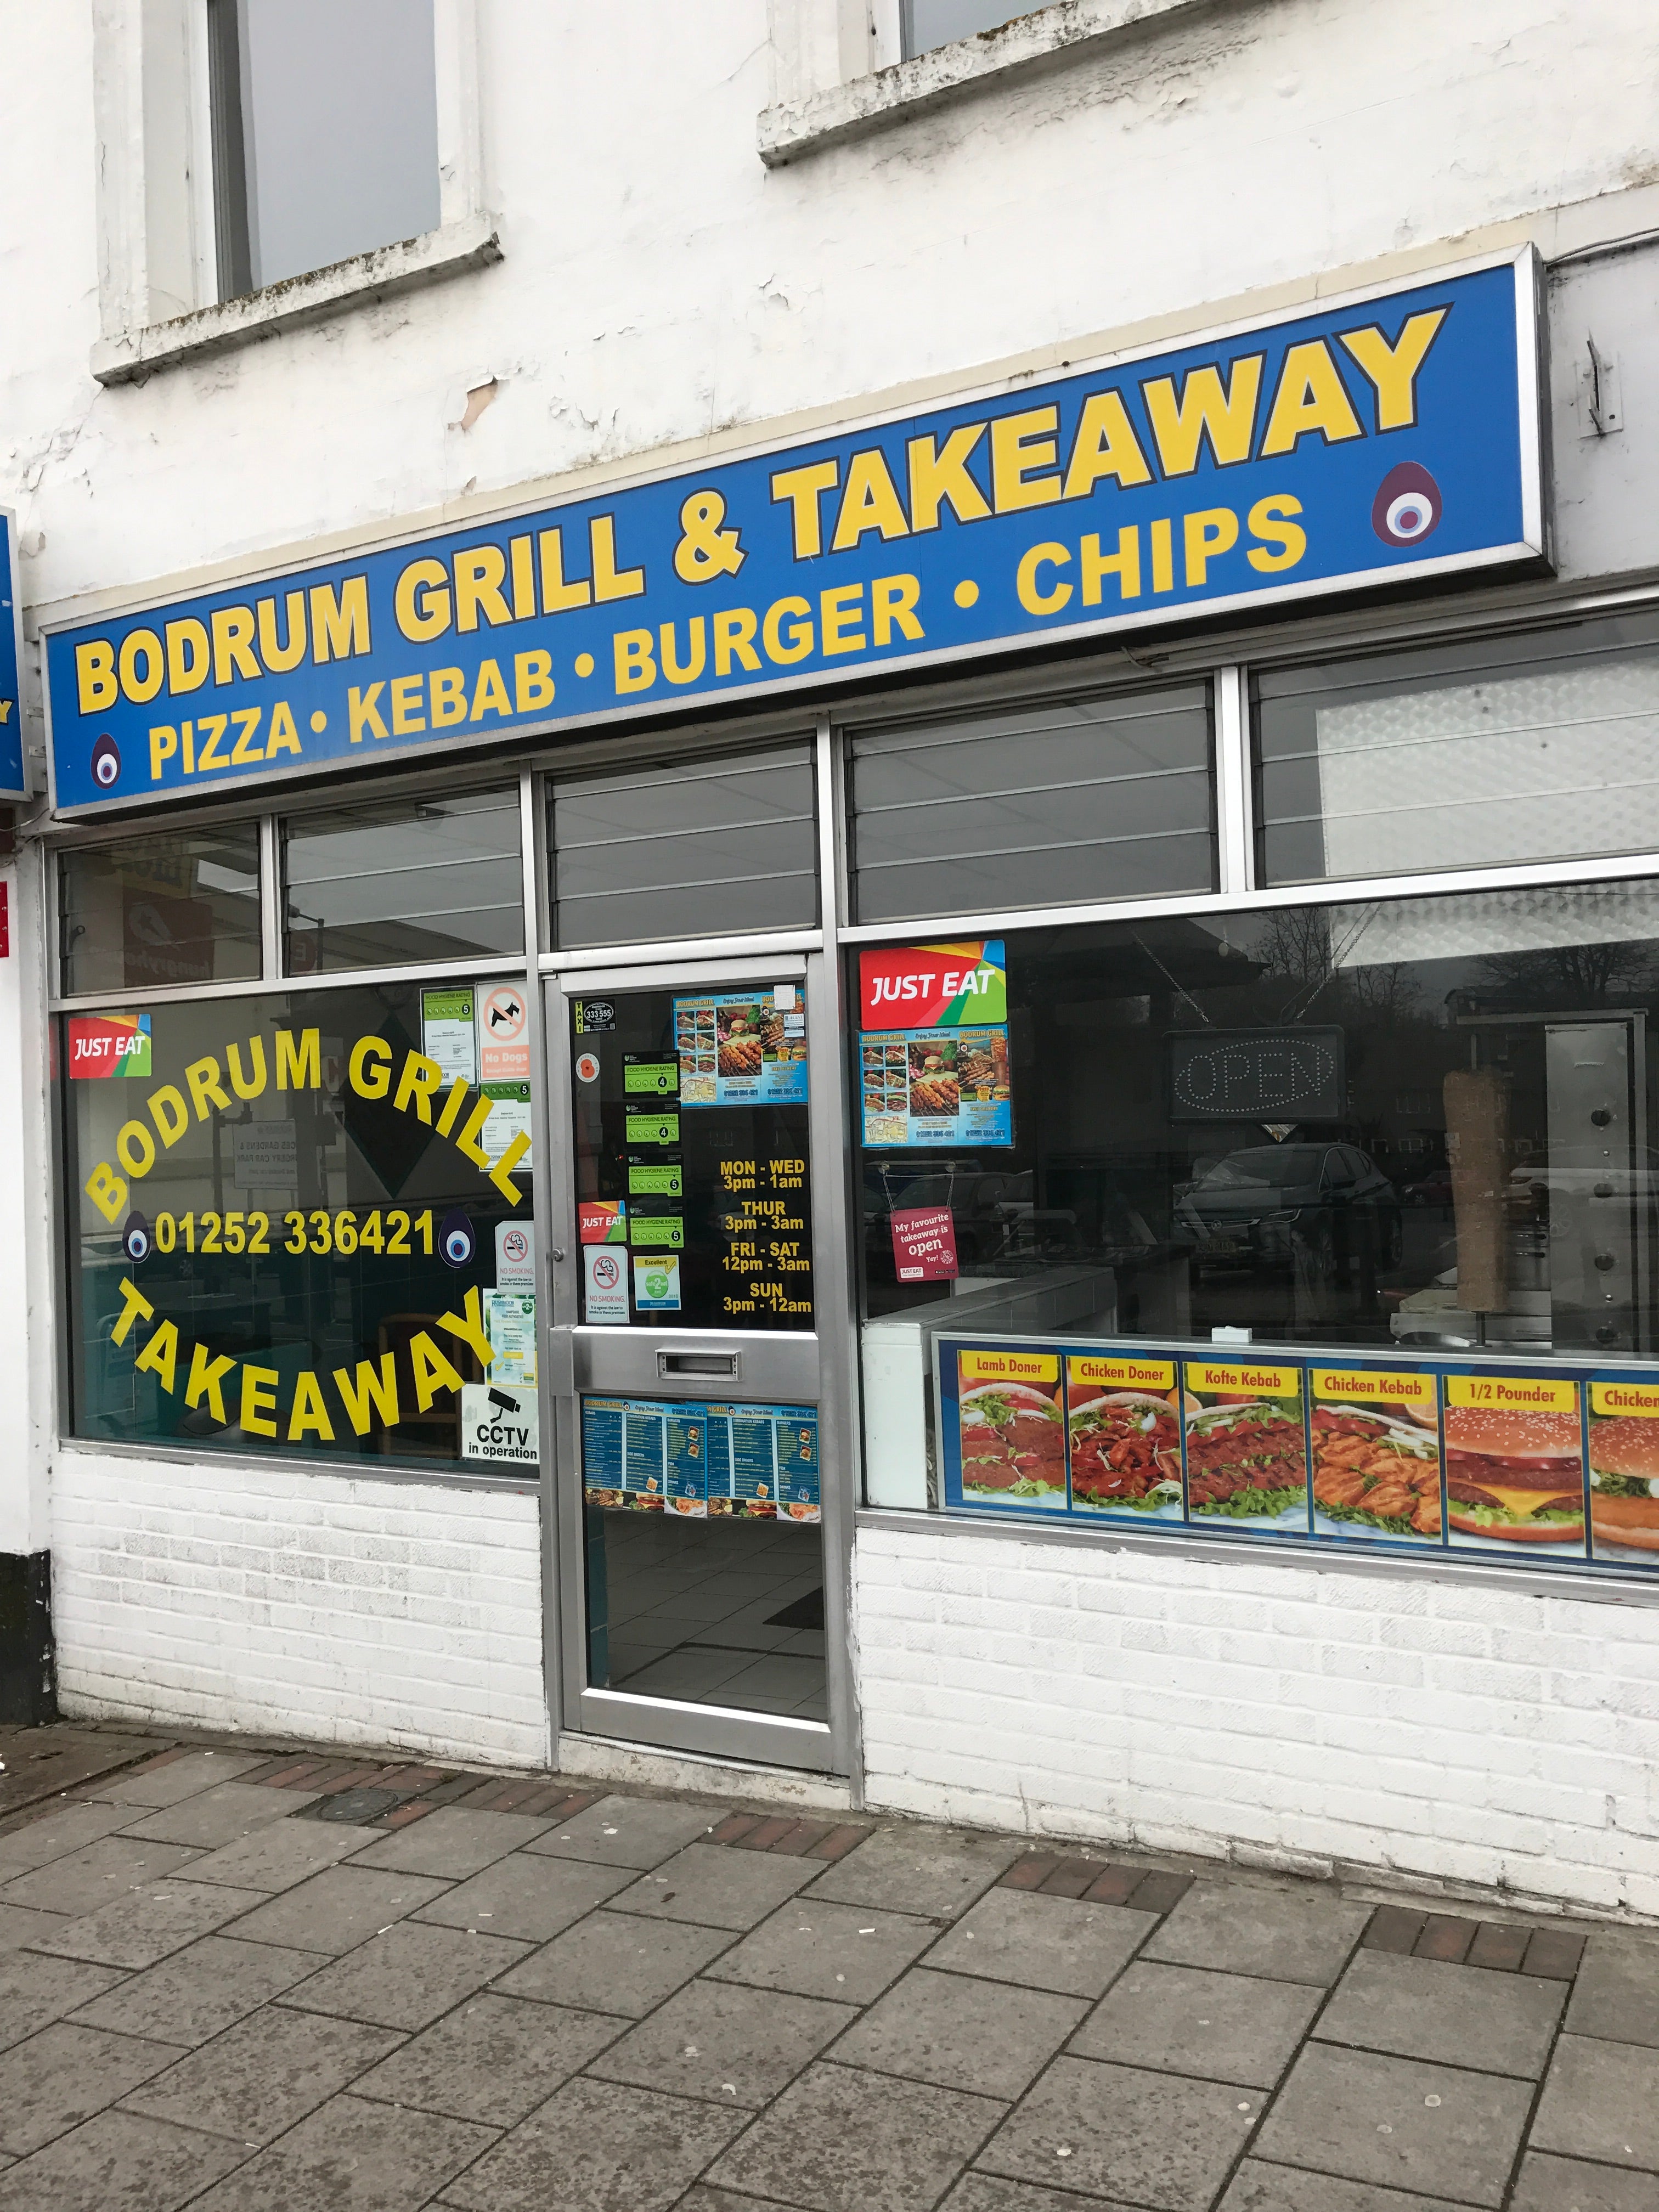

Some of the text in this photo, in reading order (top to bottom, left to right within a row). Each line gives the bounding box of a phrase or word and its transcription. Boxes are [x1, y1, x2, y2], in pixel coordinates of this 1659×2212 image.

[75, 307, 1447, 714] BODRUM GRILL & TAKEAWAY
[150, 494, 1306, 779] PIZZA KEBAB BURGER CHIPS
[870, 969, 995, 1006] JUST EAT
[464, 1005, 469, 1014] 5
[599, 1009, 611, 1017] 555
[960, 1029, 1005, 1039] BODRUM GRILL
[75, 1036, 145, 1060] JUST EAT
[485, 1052, 528, 1064] No Dogs
[659, 1077, 665, 1086] 4
[1188, 1052, 1321, 1100] OPEN
[522, 1085, 527, 1094] 5
[84, 1028, 532, 1223] BODRUM GRILL
[661, 1128, 666, 1136] 4
[720, 1161, 755, 1175] MON
[769, 1159, 805, 1174] WED
[672, 1181, 677, 1189] 5
[724, 1175, 755, 1192] 3pm
[770, 1174, 802, 1188] 1am
[741, 1201, 786, 1215] THUR
[583, 1216, 623, 1228] JUST EAT
[725, 1215, 757, 1233] 3pm
[771, 1215, 804, 1229] 3am
[895, 1214, 949, 1233] My favourite
[156, 1210, 433, 1255] 01252 336421
[674, 1232, 679, 1240] 5
[900, 1225, 948, 1243] takeaway is
[731, 1242, 755, 1256] FRI
[770, 1242, 800, 1256] SAT
[909, 1239, 943, 1256] open
[722, 1256, 763, 1274] 12pm
[777, 1256, 810, 1271] 3am
[750, 1283, 783, 1297] SUN
[723, 1296, 755, 1314] 3pm
[770, 1297, 811, 1312] 12am
[111, 1278, 496, 1441] TAKEAWAY
[977, 1357, 1042, 1374] Lamb Doner
[1080, 1363, 1164, 1381] Chicken Doner
[1205, 1370, 1282, 1387] Kofte Kebab
[1324, 1376, 1423, 1396] Chicken Kebab
[1470, 1384, 1556, 1403] 1/2 Pounder
[477, 1424, 529, 1446] CCTV
[469, 1442, 537, 1459] in operation
